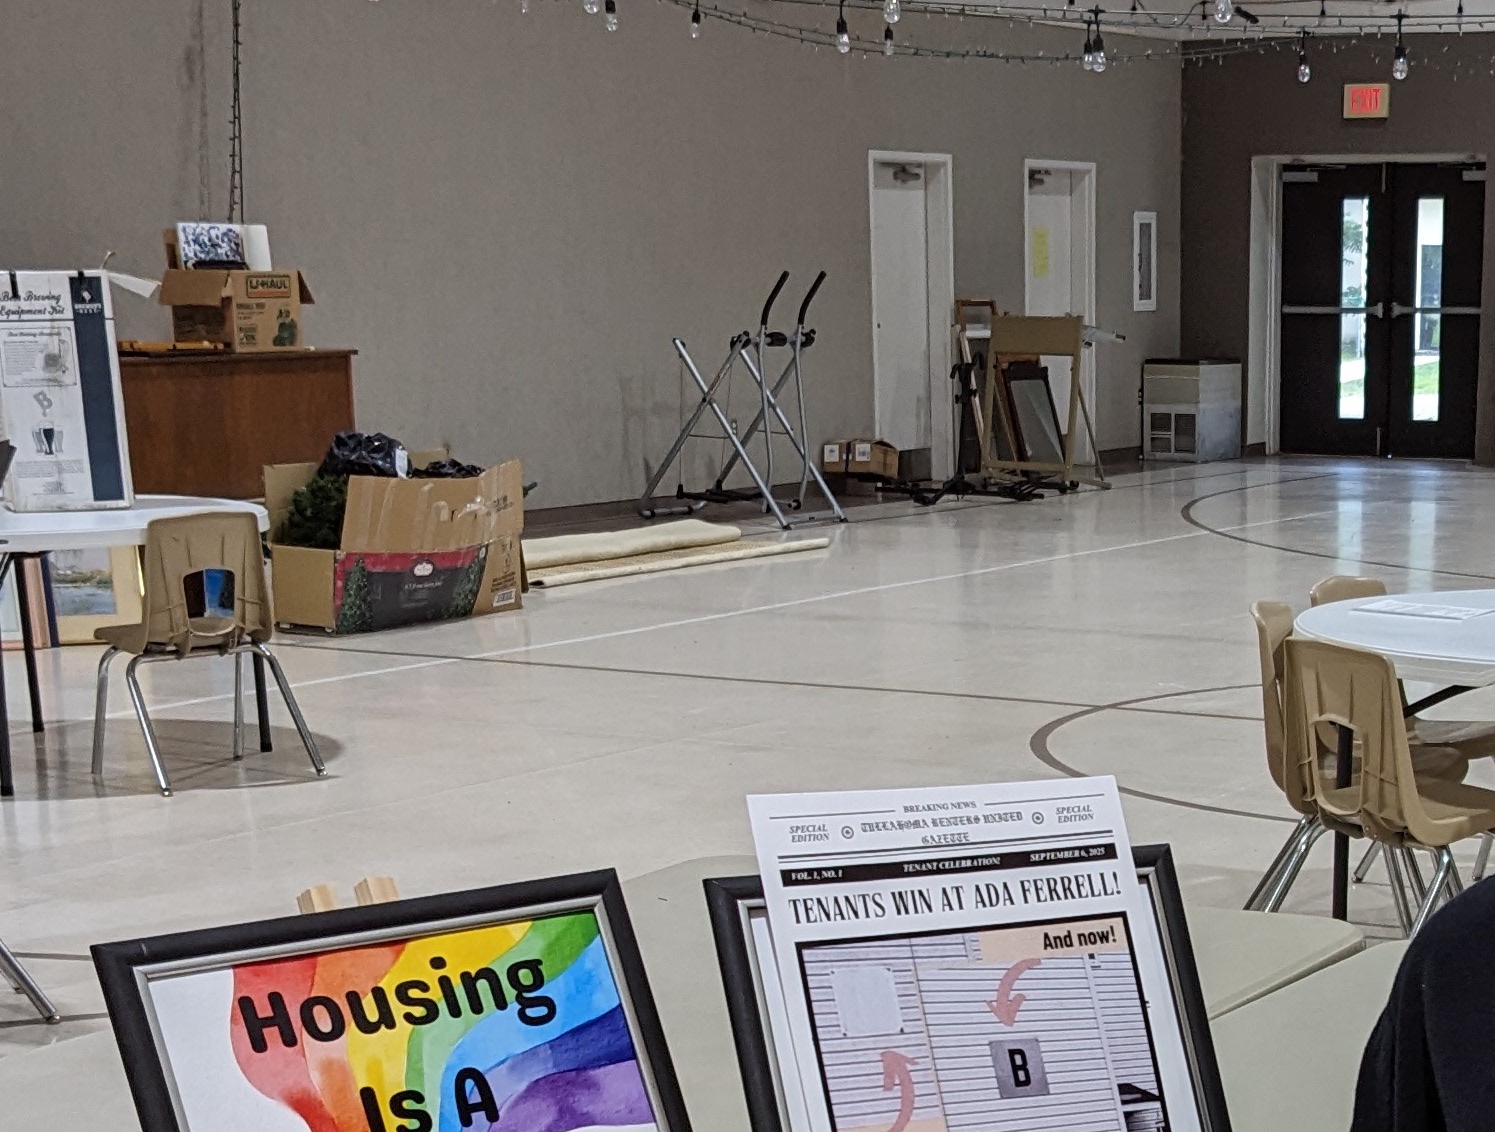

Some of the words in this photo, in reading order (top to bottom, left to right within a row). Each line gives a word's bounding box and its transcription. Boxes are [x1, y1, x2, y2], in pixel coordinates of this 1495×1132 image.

[1351, 88, 1381, 112] EXIT
[25, 291, 62, 305] Brewing
[0, 306, 47, 320] Equipment
[903, 803, 948, 812] BREAKING
[951, 801, 976, 809] NEWS
[1055, 804, 1091, 814] SPECIAL
[1057, 813, 1093, 823] EDITION
[789, 824, 827, 833] SPECIAL
[791, 833, 828, 842] EDITION
[1030, 849, 1078, 861] SEPTEMBER
[903, 861, 936, 871] TENANT
[938, 857, 1000, 868] CELEBRATION!
[791, 871, 811, 880] VOL.
[788, 893, 885, 923] TENANTS
[891, 889, 932, 915] WIN
[941, 885, 963, 911] AT
[975, 881, 1014, 907] ADA
[1020, 872, 1119, 903] FERRELL!
[1043, 930, 1073, 949] And
[1077, 925, 1116, 945] now!
[239, 957, 556, 1054] Housing
[1008, 1048, 1031, 1087] B
[456, 1067, 500, 1126] A
